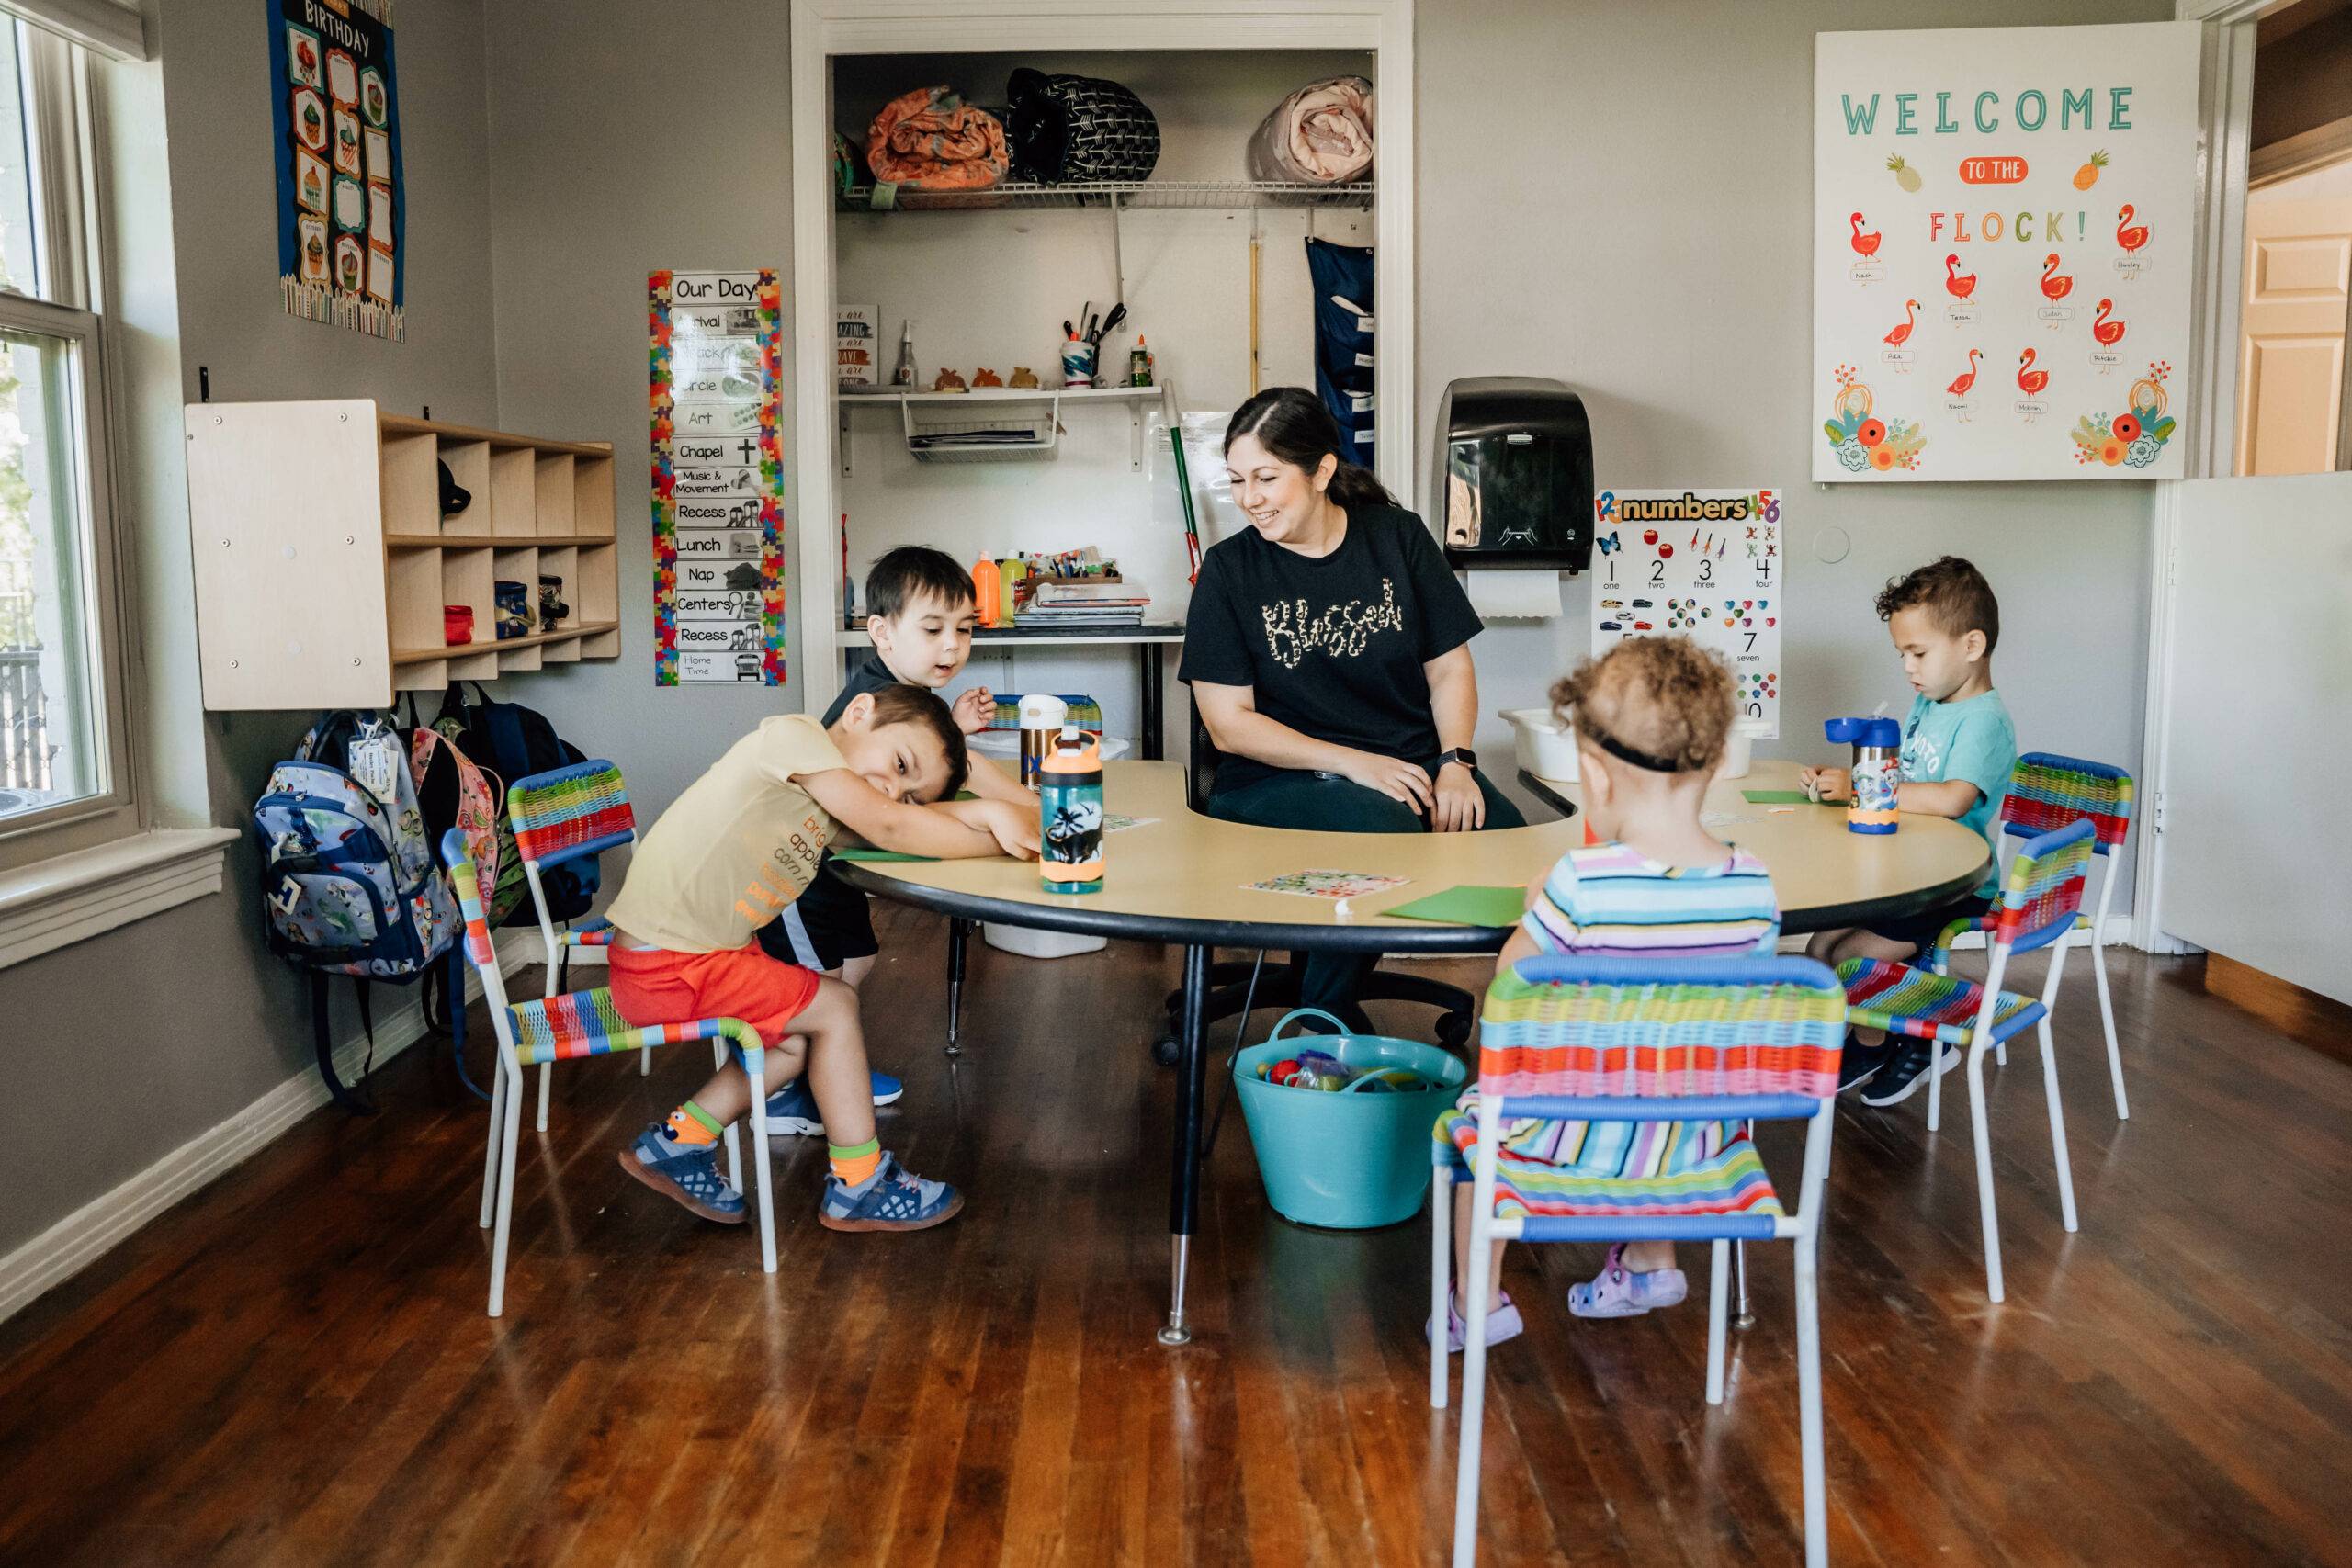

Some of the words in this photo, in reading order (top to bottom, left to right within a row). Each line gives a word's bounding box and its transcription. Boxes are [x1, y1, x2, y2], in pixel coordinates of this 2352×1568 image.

[305, 0, 369, 57] BIRTHDAY
[1841, 86, 2134, 135] WELCOME
[1966, 161, 1985, 179] TO
[1992, 160, 2021, 179] THE
[1930, 210, 2086, 242] FLOCK!
[677, 279, 712, 298] Our
[718, 279, 756, 301] Day
[689, 412, 713, 425] Art
[680, 445, 724, 460] Chapel
[683, 470, 710, 481] Music
[714, 470, 721, 481] &
[676, 483, 729, 494] Movement
[679, 505, 726, 518] Recess
[1622, 492, 1748, 521] numbers
[676, 537, 721, 551] Lunch
[689, 568, 715, 583] Nap
[1610, 560, 1614, 581] 1
[1651, 559, 1664, 581] 2
[1699, 559, 1712, 581] 3
[1756, 558, 1770, 580] 4
[1648, 581, 1665, 589] two
[1693, 581, 1715, 589] three
[1755, 580, 1773, 588] four
[678, 597, 731, 611] Centers
[1261, 576, 1403, 669] Blessed
[681, 628, 728, 641] Recess
[1744, 632, 1758, 653] 7
[684, 655, 711, 665] Home
[1736, 654, 1760, 662] seven
[684, 667, 709, 675] Time
[774, 848, 802, 874] corn
